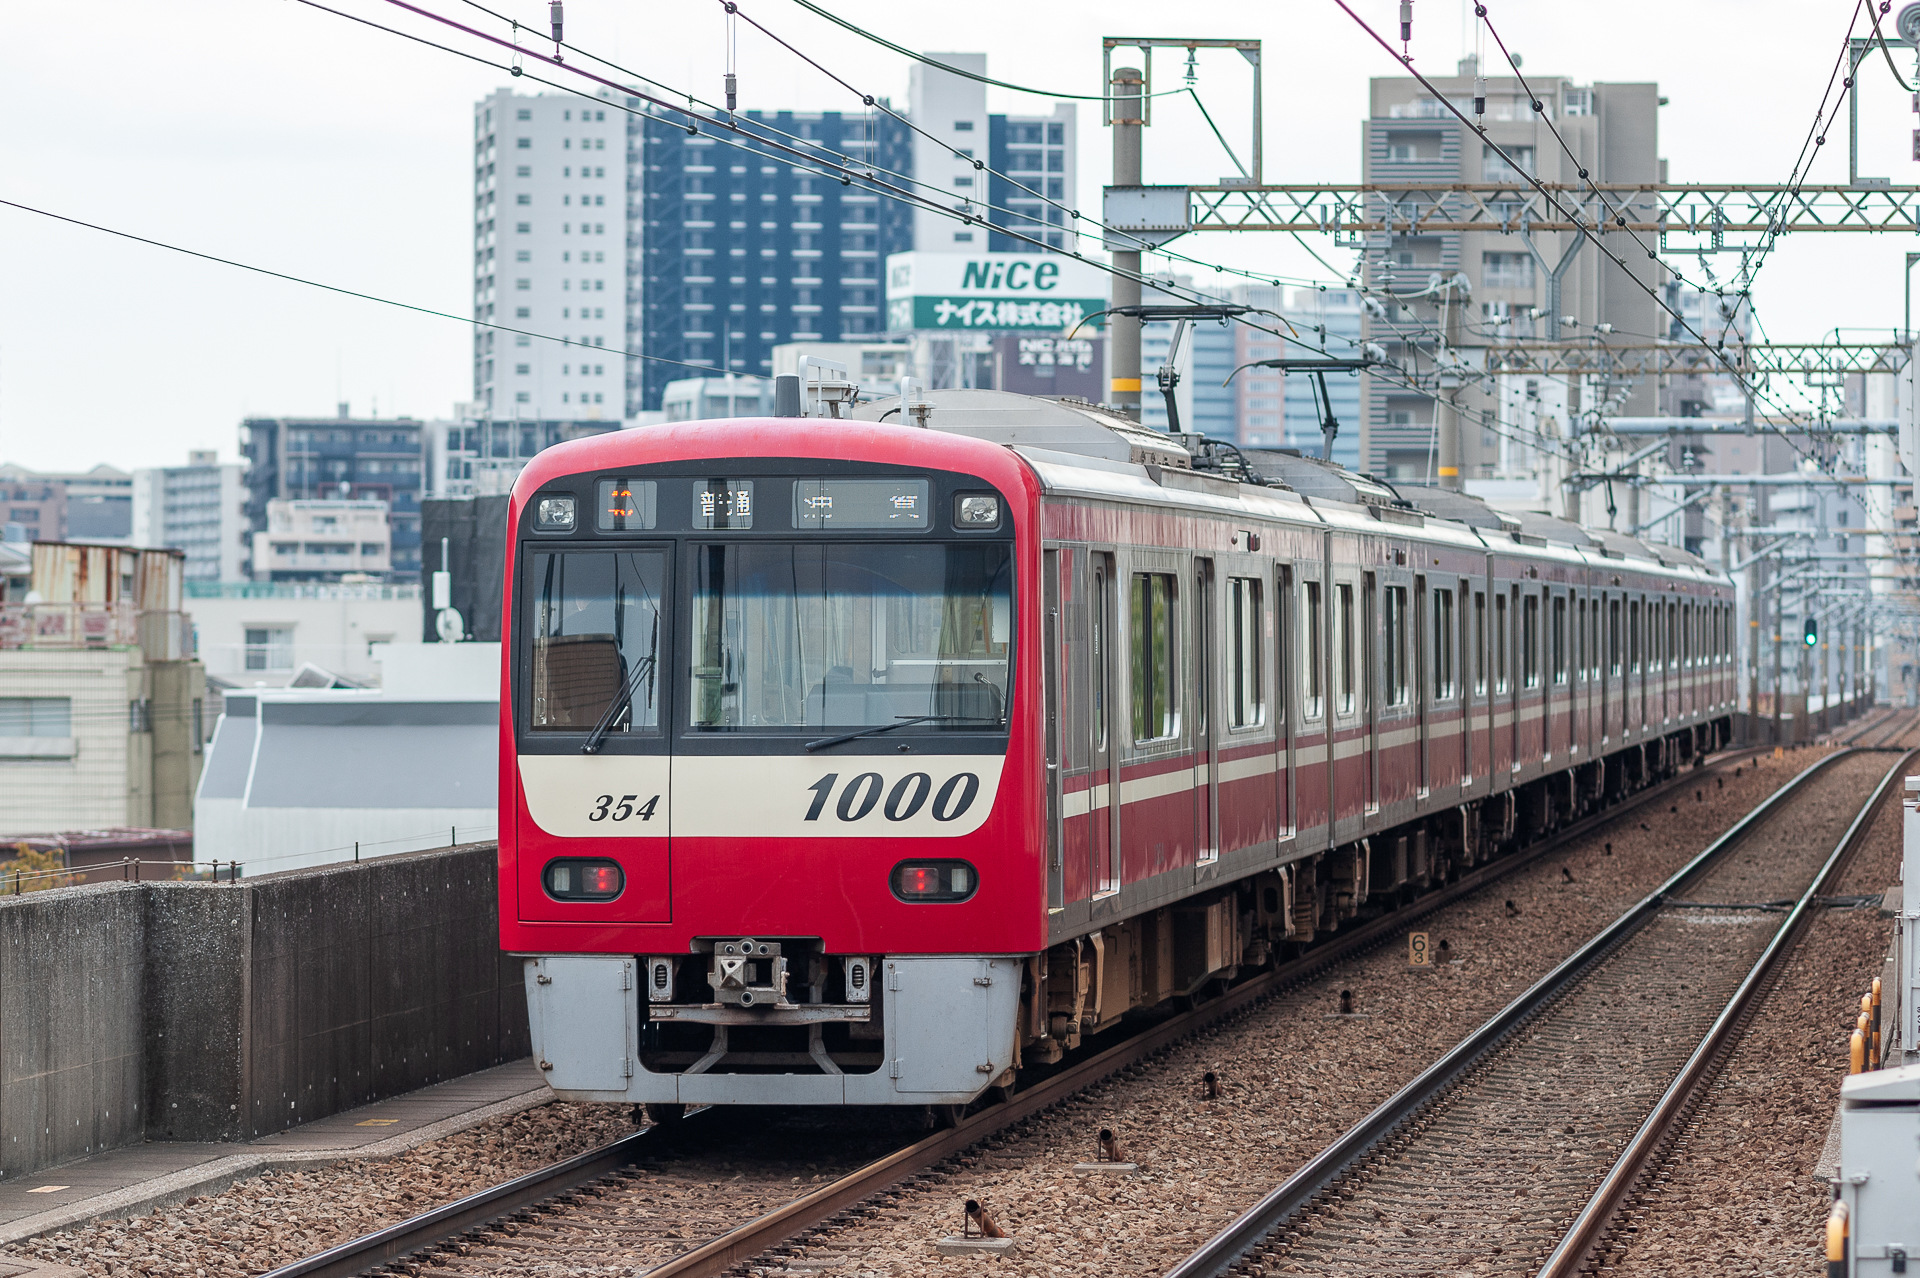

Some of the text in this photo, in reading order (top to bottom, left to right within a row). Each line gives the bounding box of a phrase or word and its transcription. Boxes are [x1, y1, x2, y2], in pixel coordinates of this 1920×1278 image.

[933, 299, 1085, 327] ナイス株式会社
[588, 794, 661, 822] 354
[803, 772, 980, 822] 1000
[1412, 934, 1426, 952] 6
[1414, 952, 1424, 964] 3
